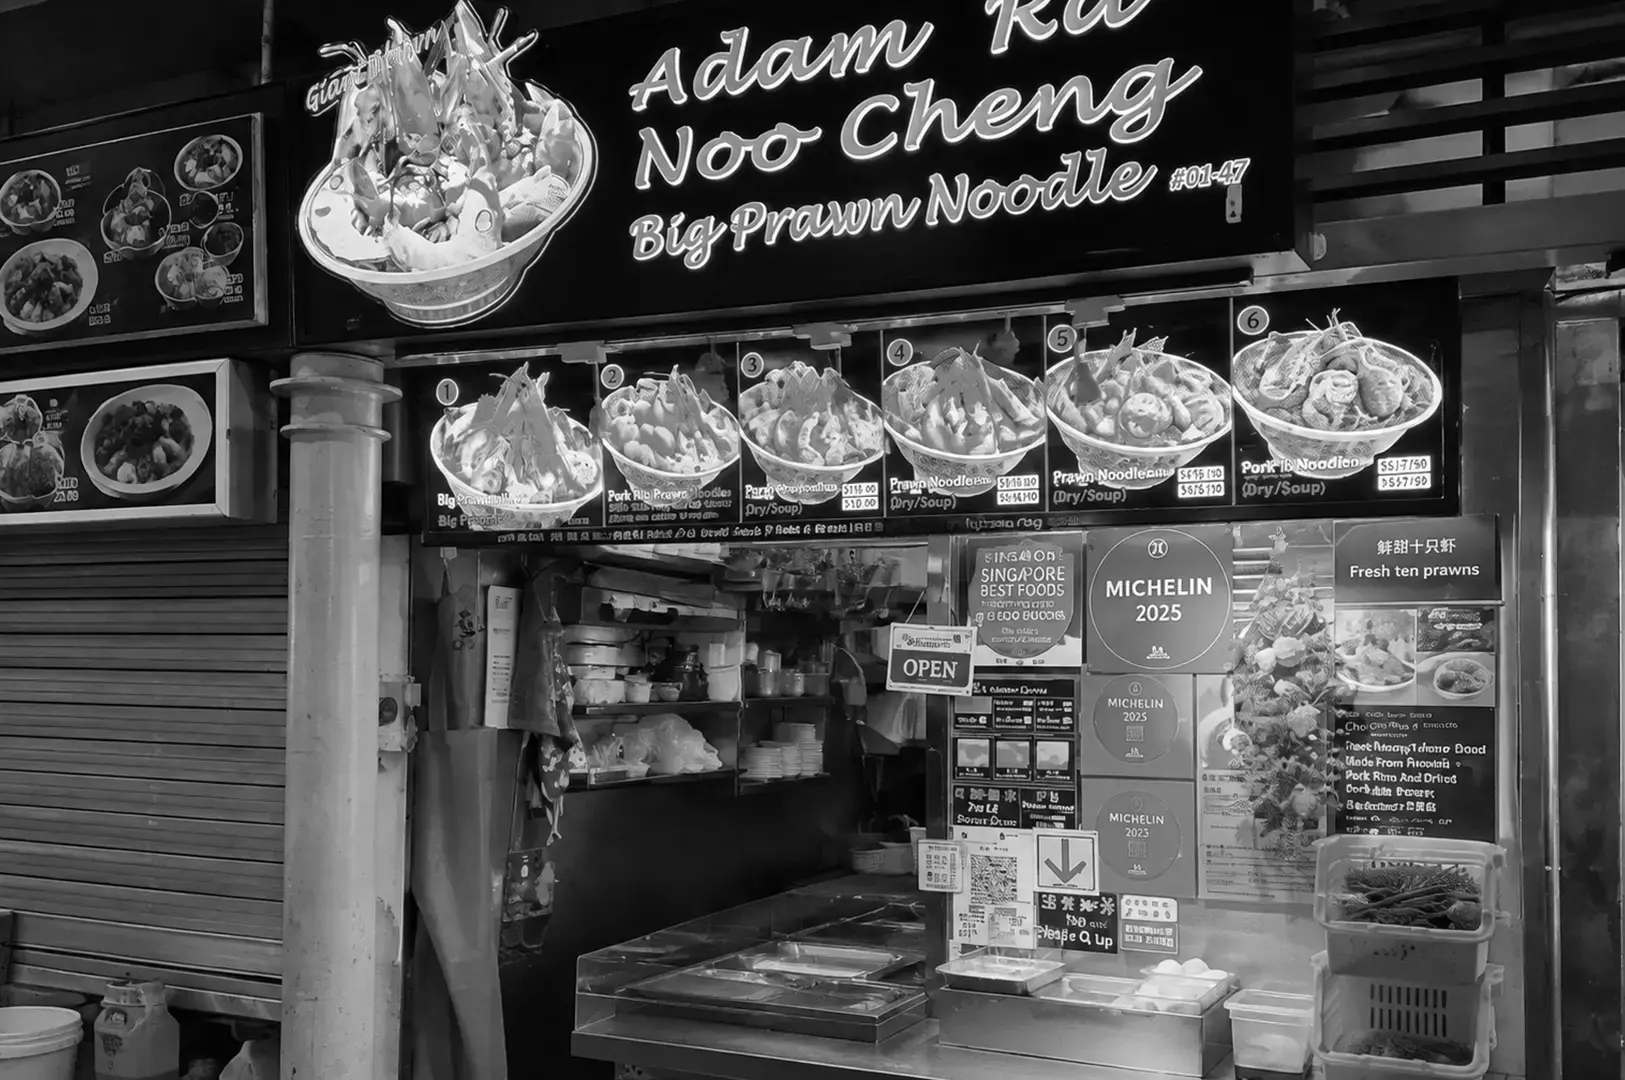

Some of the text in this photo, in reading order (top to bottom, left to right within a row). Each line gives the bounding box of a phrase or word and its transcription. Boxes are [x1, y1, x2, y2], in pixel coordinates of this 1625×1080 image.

[628, 19, 934, 111] Adam
[635, 57, 1203, 189] Noo Cheng
[629, 147, 1251, 269] Big Prawn Noodle #01-47
[1053, 488, 1127, 505] (Dry/Soup)
[1242, 481, 1326, 498] (Dry/Soup)
[437, 492, 456, 509] Big
[981, 566, 1066, 582] SINGAPORE
[1350, 564, 1480, 579] Fresh ten prawns
[981, 583, 1065, 597] BEST FOODS
[1106, 576, 1212, 598] MICHELIN
[1135, 604, 1182, 623] 2025
[903, 659, 958, 679] OPEN
[1108, 698, 1164, 709] MICHELIN
[1123, 711, 1148, 722] 2025
[1109, 812, 1164, 825] MICHELIN
[1079, 930, 1092, 946] Q
